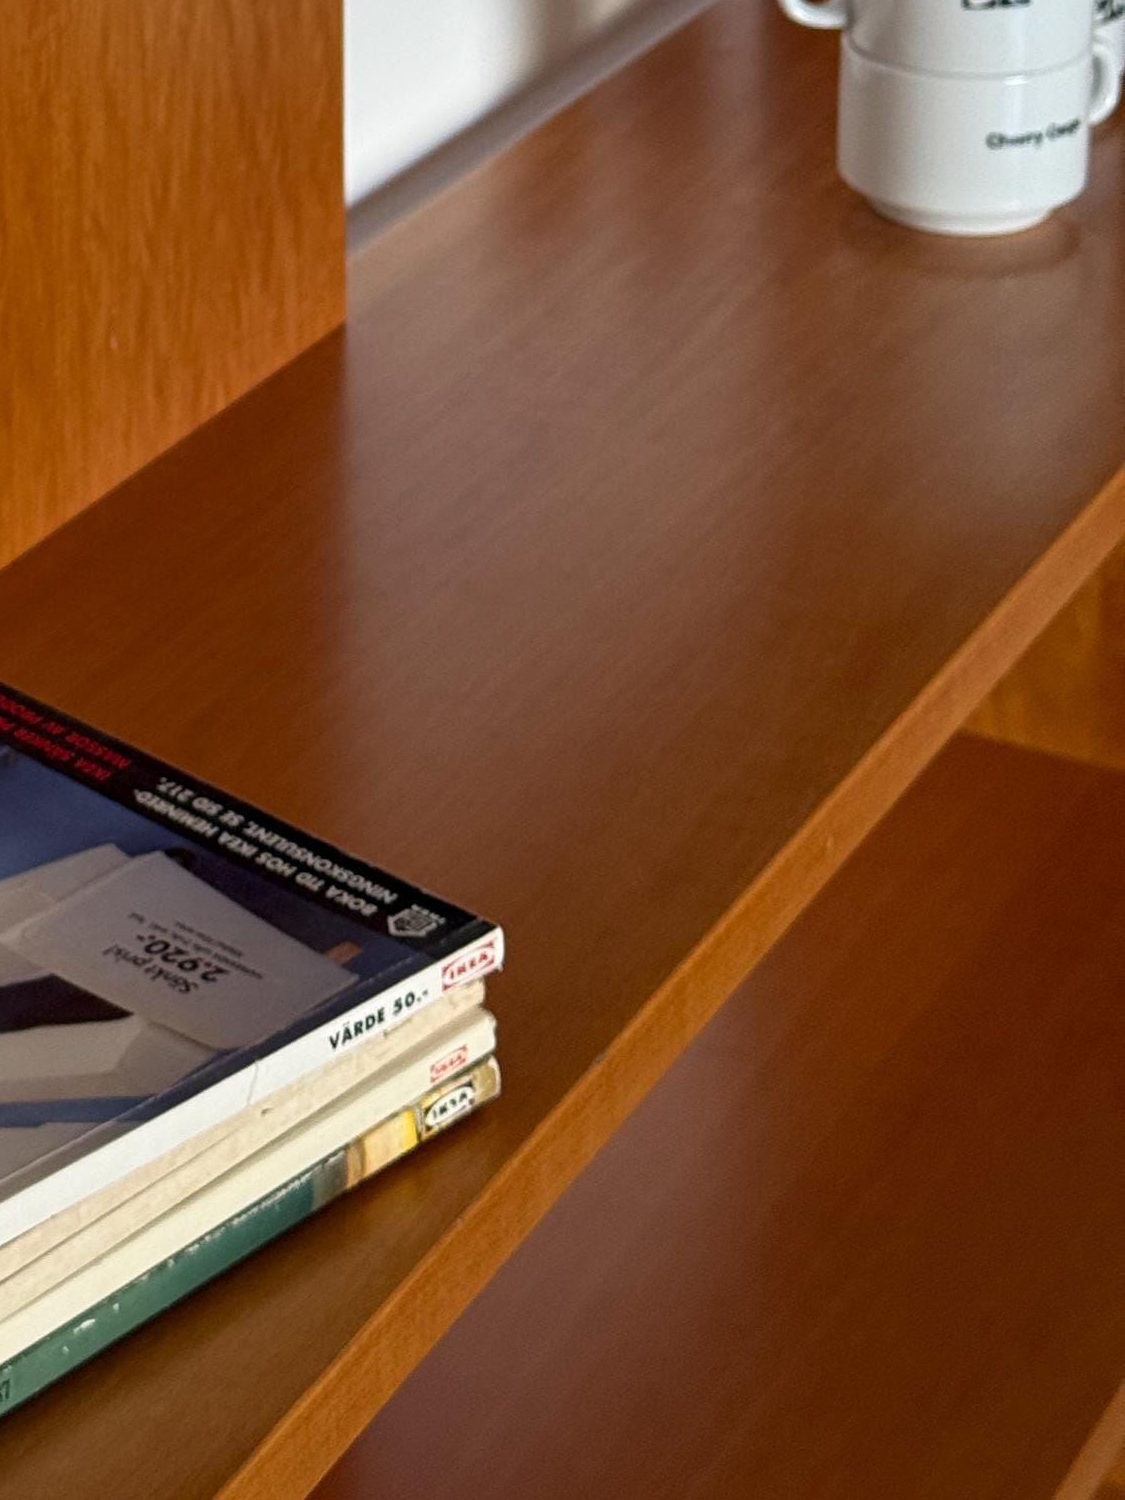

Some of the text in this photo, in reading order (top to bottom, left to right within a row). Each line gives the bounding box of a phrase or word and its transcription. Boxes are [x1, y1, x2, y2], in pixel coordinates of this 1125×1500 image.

[217, 830, 259, 858] IKEA
[255, 851, 297, 878] HOS
[295, 871, 326, 893] TID
[325, 885, 378, 917] BOKA
[448, 950, 490, 980] IKEA
[328, 1006, 386, 1050] VÄRDE
